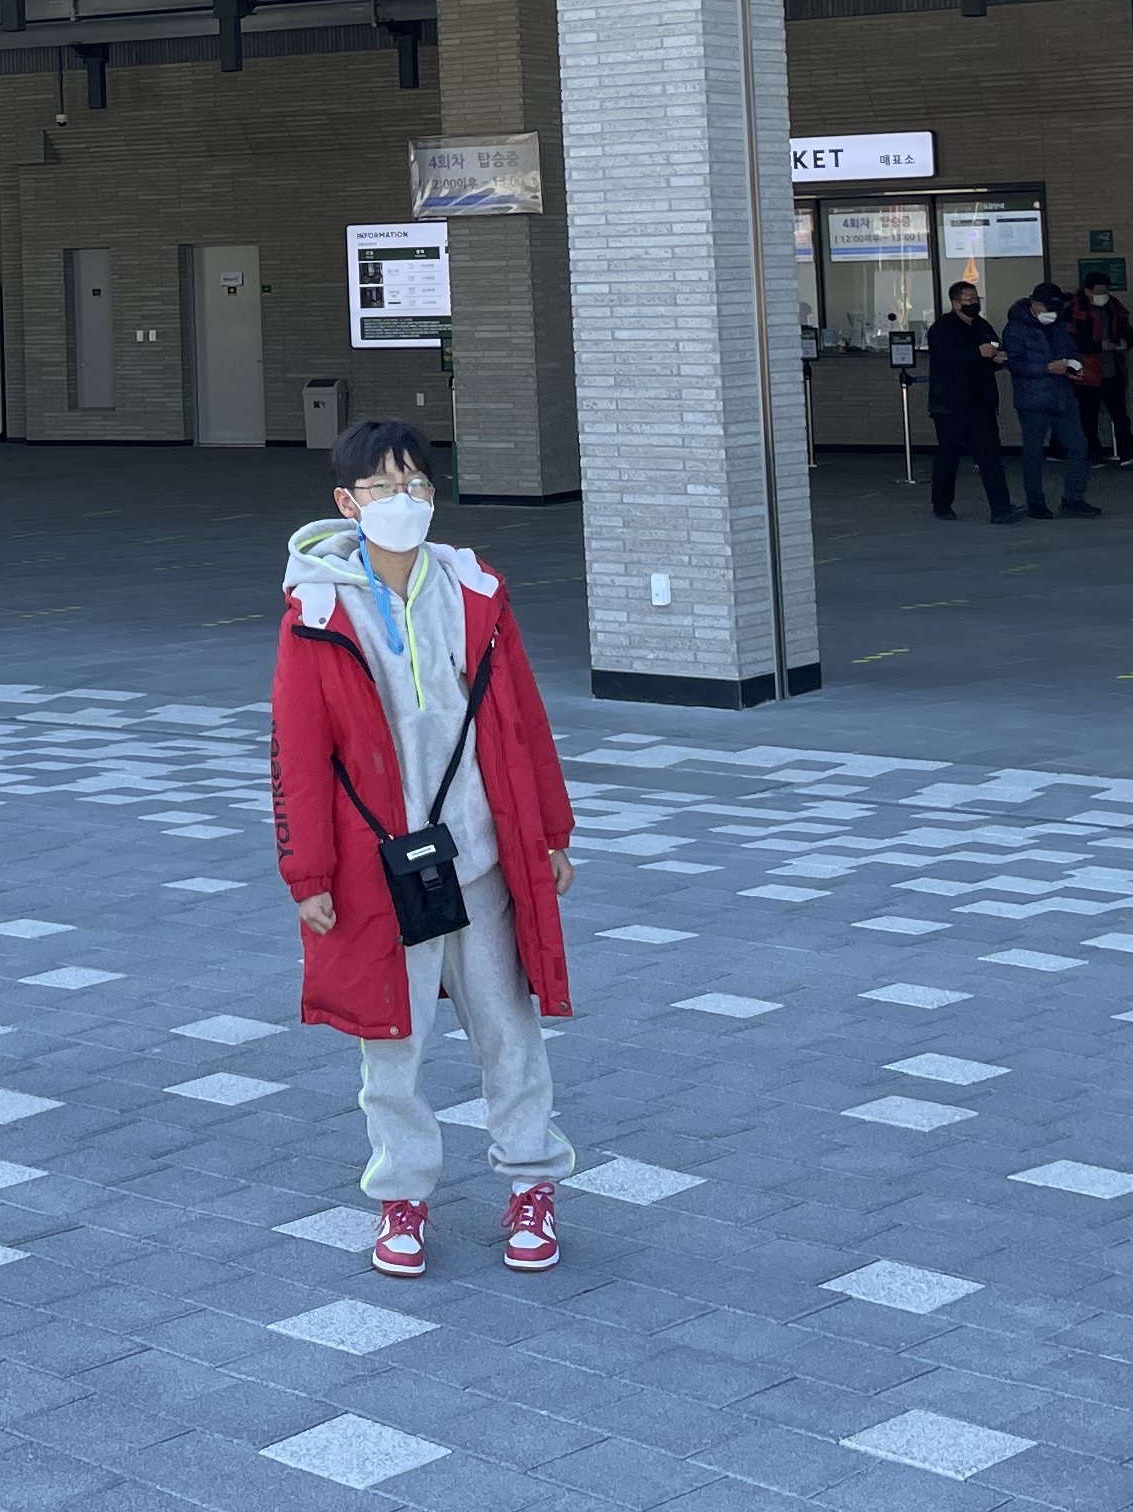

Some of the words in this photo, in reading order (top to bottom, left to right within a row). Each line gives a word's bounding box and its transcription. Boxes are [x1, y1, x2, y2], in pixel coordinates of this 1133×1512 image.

[428, 153, 465, 170] 4회차
[477, 150, 520, 168] 탑승중
[879, 154, 915, 166] 매표소
[427, 176, 478, 190] 2:00이후
[842, 217, 870, 229] 4회차
[356, 231, 409, 240] INFORMATION
